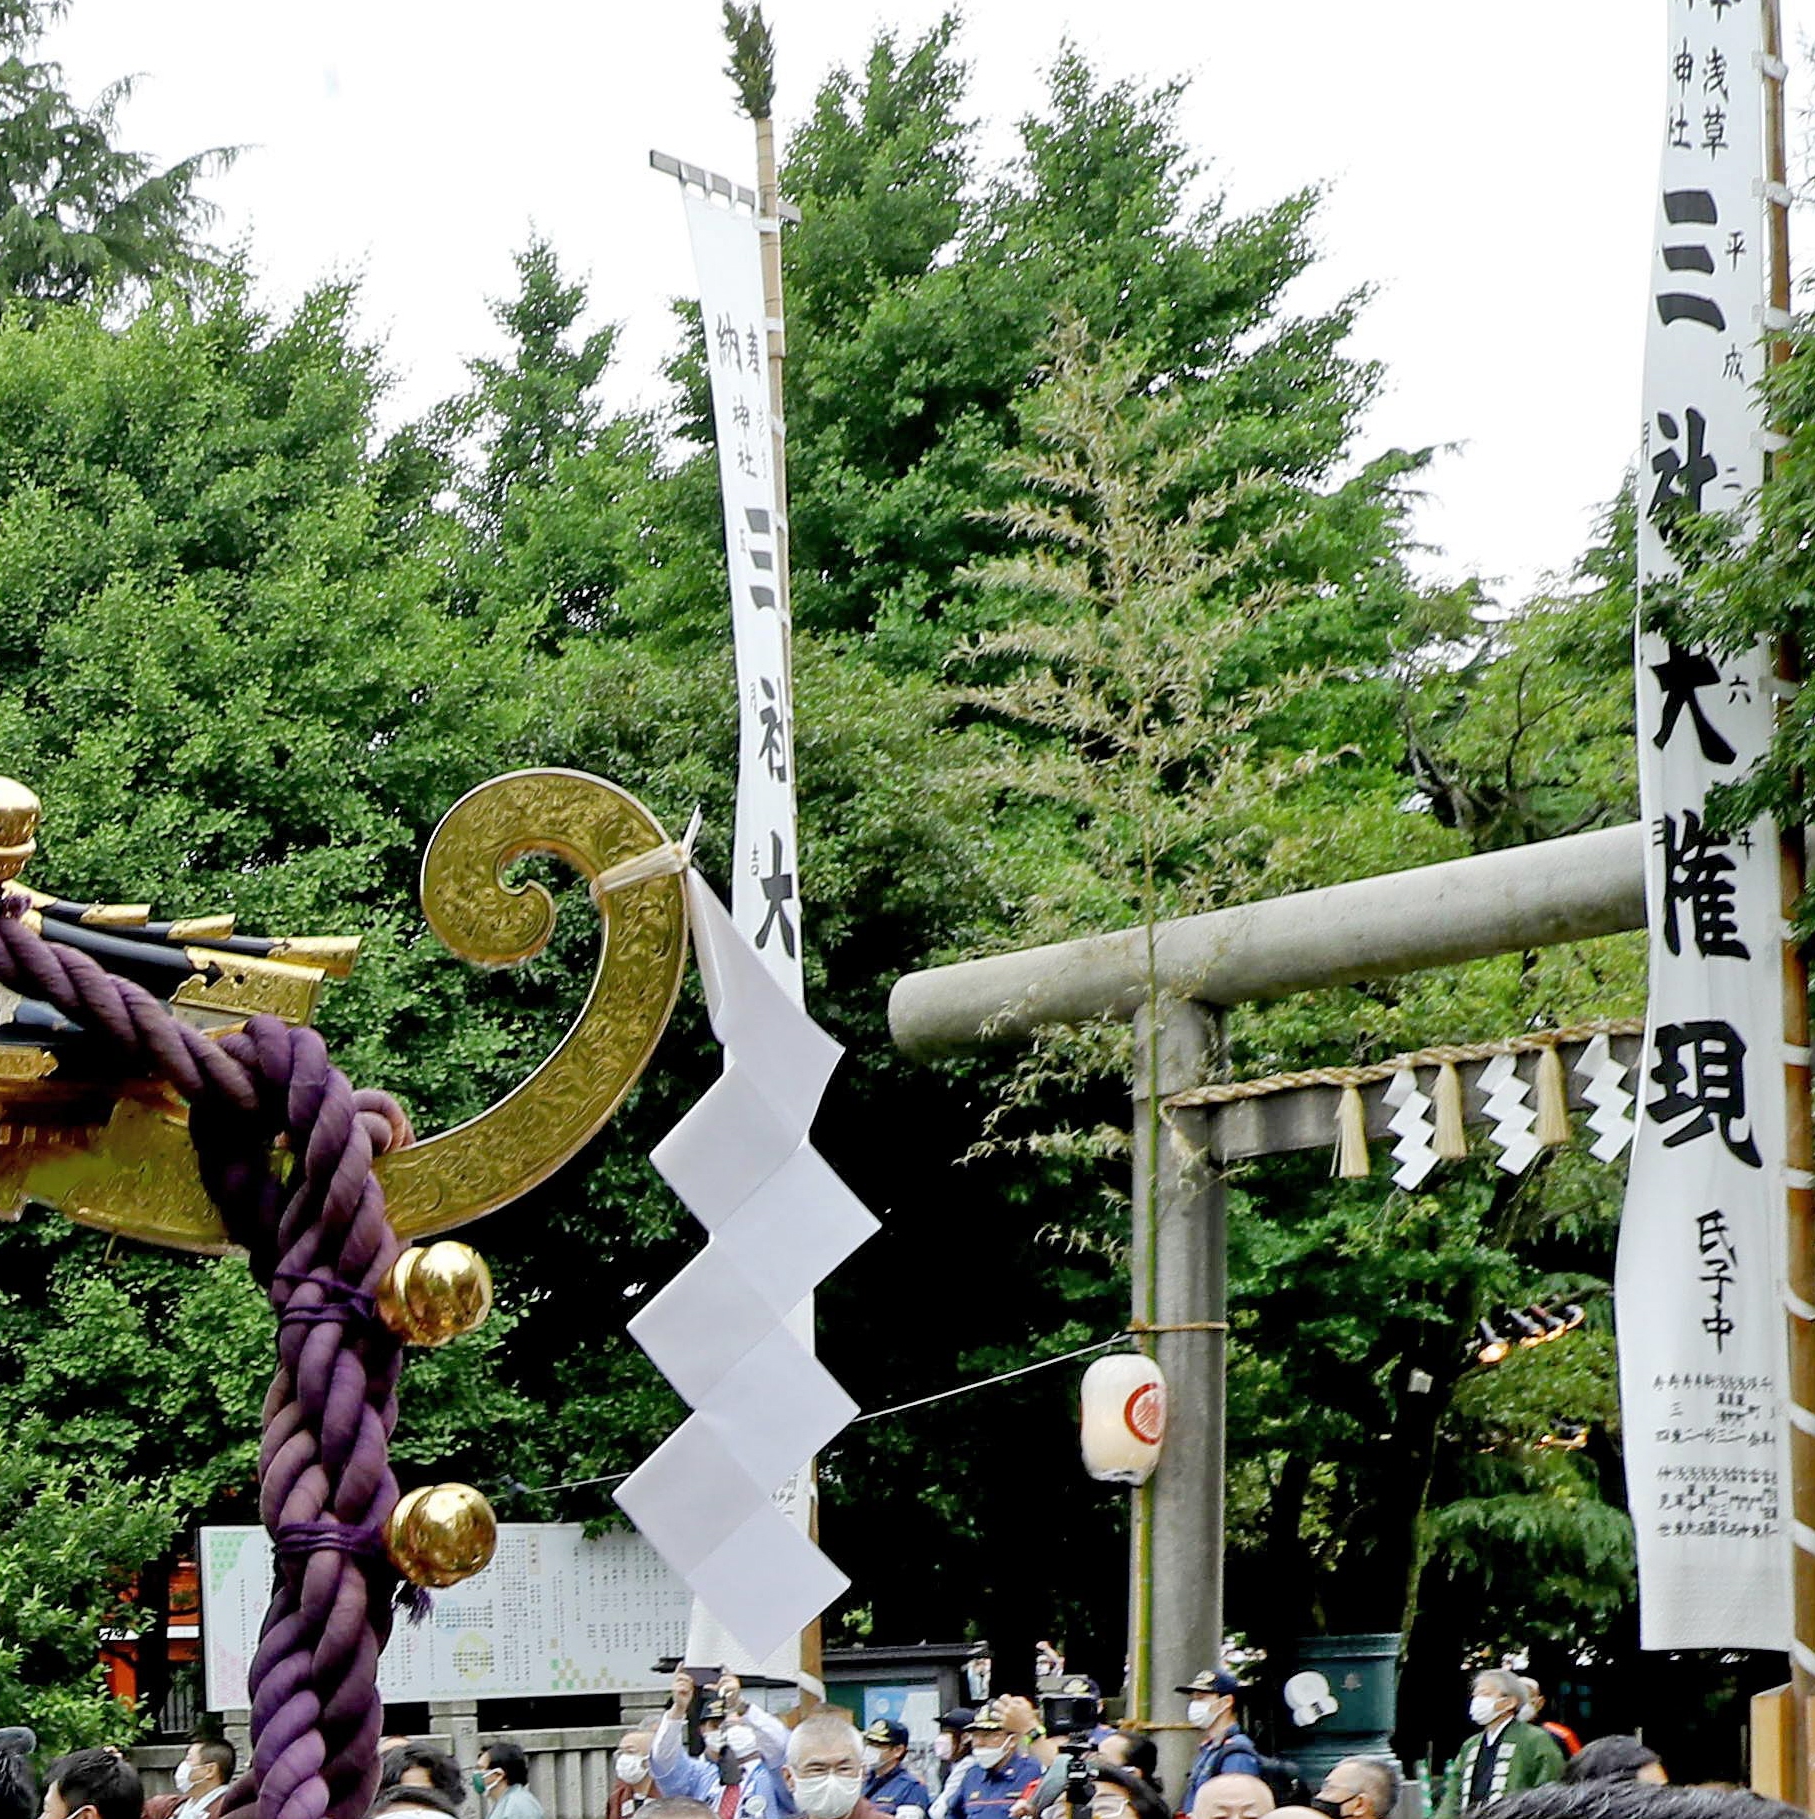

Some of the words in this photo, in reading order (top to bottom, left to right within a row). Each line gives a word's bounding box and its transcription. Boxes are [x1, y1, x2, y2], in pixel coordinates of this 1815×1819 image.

[1669, 36, 1695, 150] 神社
[1701, 45, 1731, 161] 浅草
[1694, 1208, 1738, 1355] 氏子中
